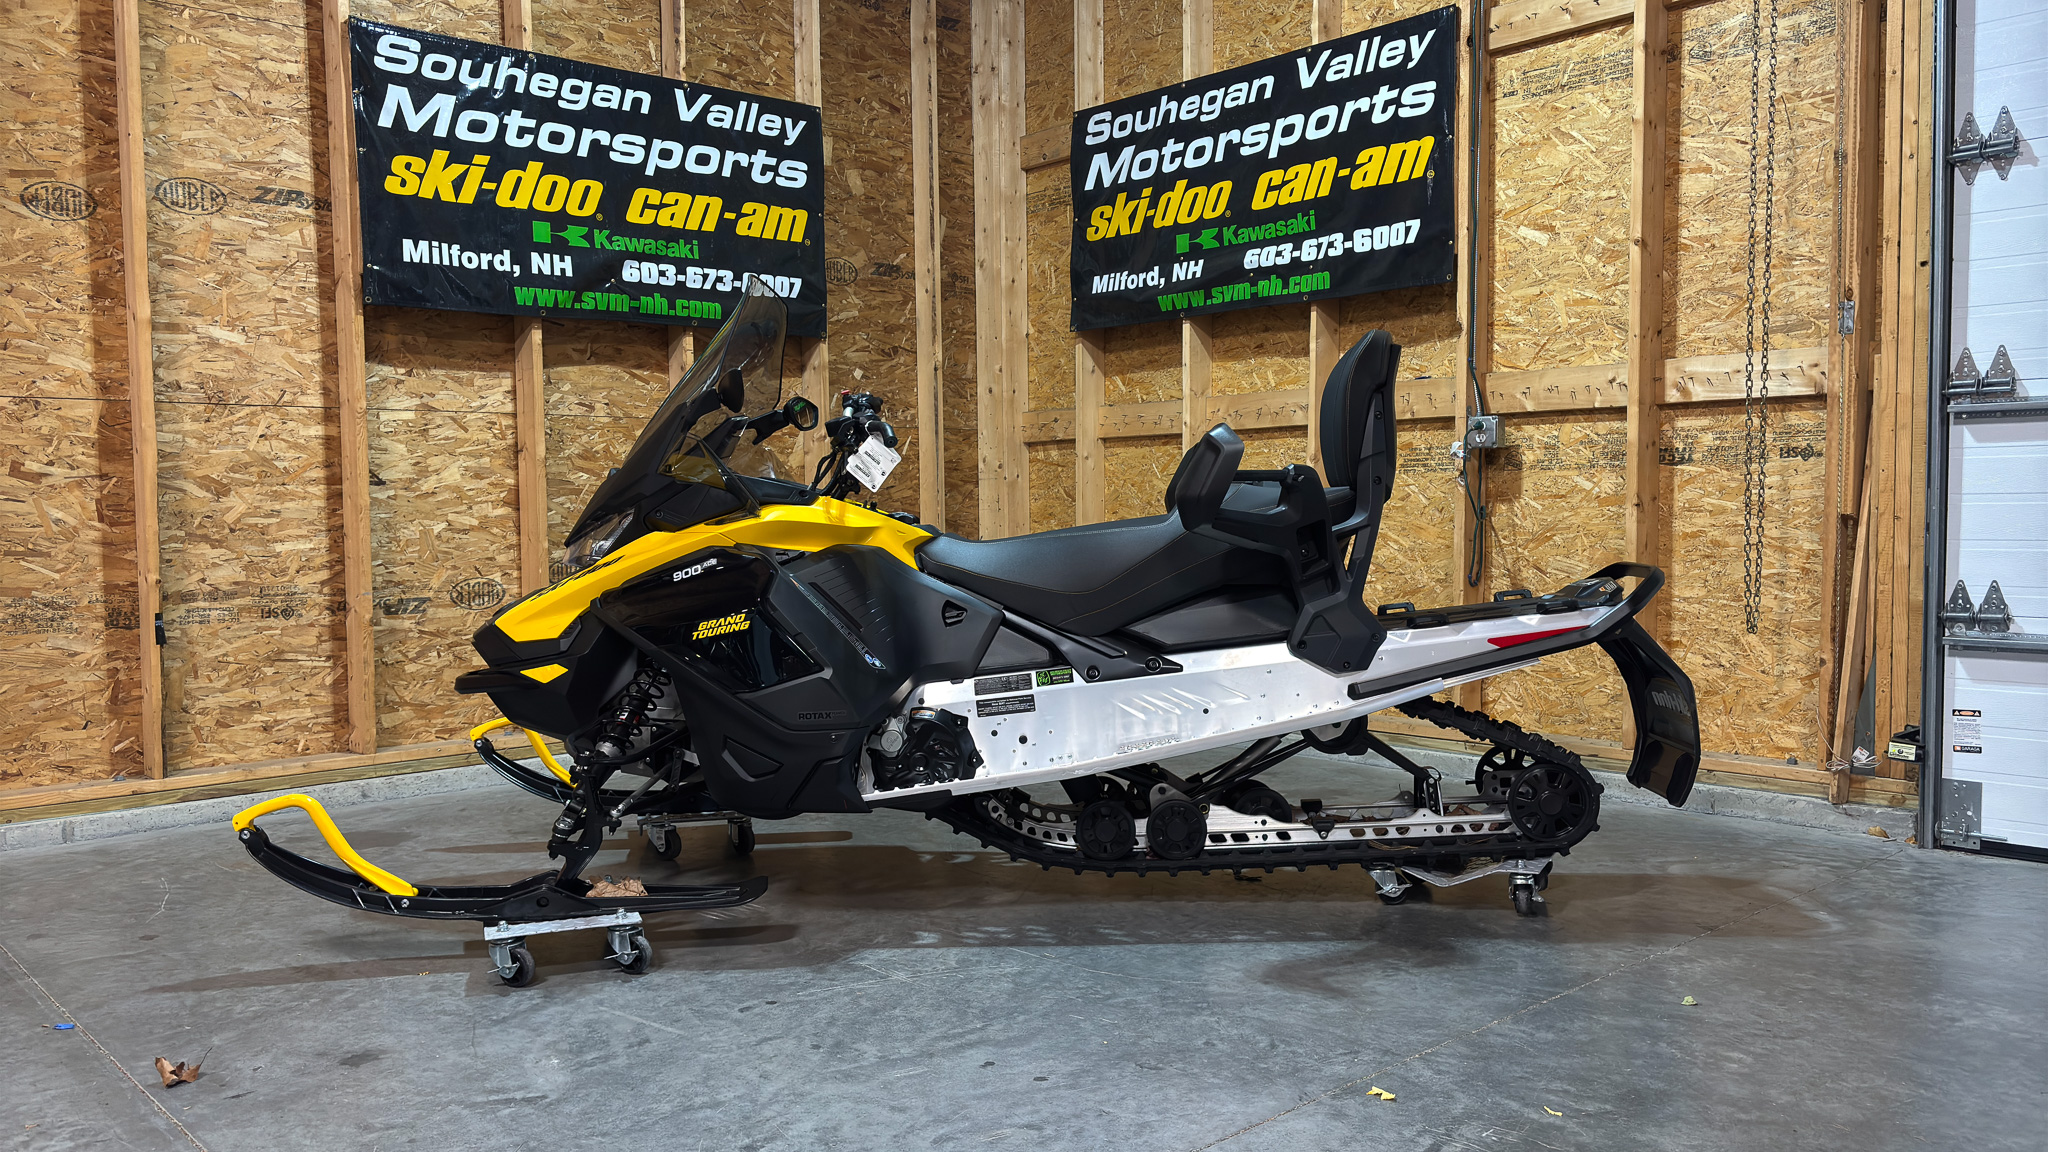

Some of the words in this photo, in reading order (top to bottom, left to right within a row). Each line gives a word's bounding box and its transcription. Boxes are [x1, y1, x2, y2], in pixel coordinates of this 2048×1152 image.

[373, 34, 652, 114] Souhegan
[674, 88, 807, 146] Valley
[1084, 74, 1275, 146] Souhegan
[1297, 28, 1437, 90] Valley
[376, 84, 808, 188] Motorsports
[1084, 80, 1437, 191] Motorsports
[26, 186, 92, 217] HUBER
[161, 180, 224, 214] HUBER
[384, 149, 604, 218] ski-doo
[625, 187, 808, 243] can-am
[1086, 179, 1234, 242] ski-doo
[1251, 135, 1436, 211] can-am
[593, 229, 700, 260] Kawasaki
[1222, 210, 1317, 246] Kawasaki
[1243, 218, 1421, 270] 603-673-6007
[402, 238, 521, 277] Milford,
[531, 252, 573, 278] NH
[1091, 270, 1166, 295] Milford,
[1172, 258, 1205, 284] NH
[514, 285, 722, 320] www.svm-nh.com
[1157, 268, 1331, 312] www.svm-nh.com
[673, 564, 701, 582] 900
[692, 620, 751, 640] TOURING
[698, 613, 746, 631] GRAND
[798, 710, 833, 721] ROTAX
